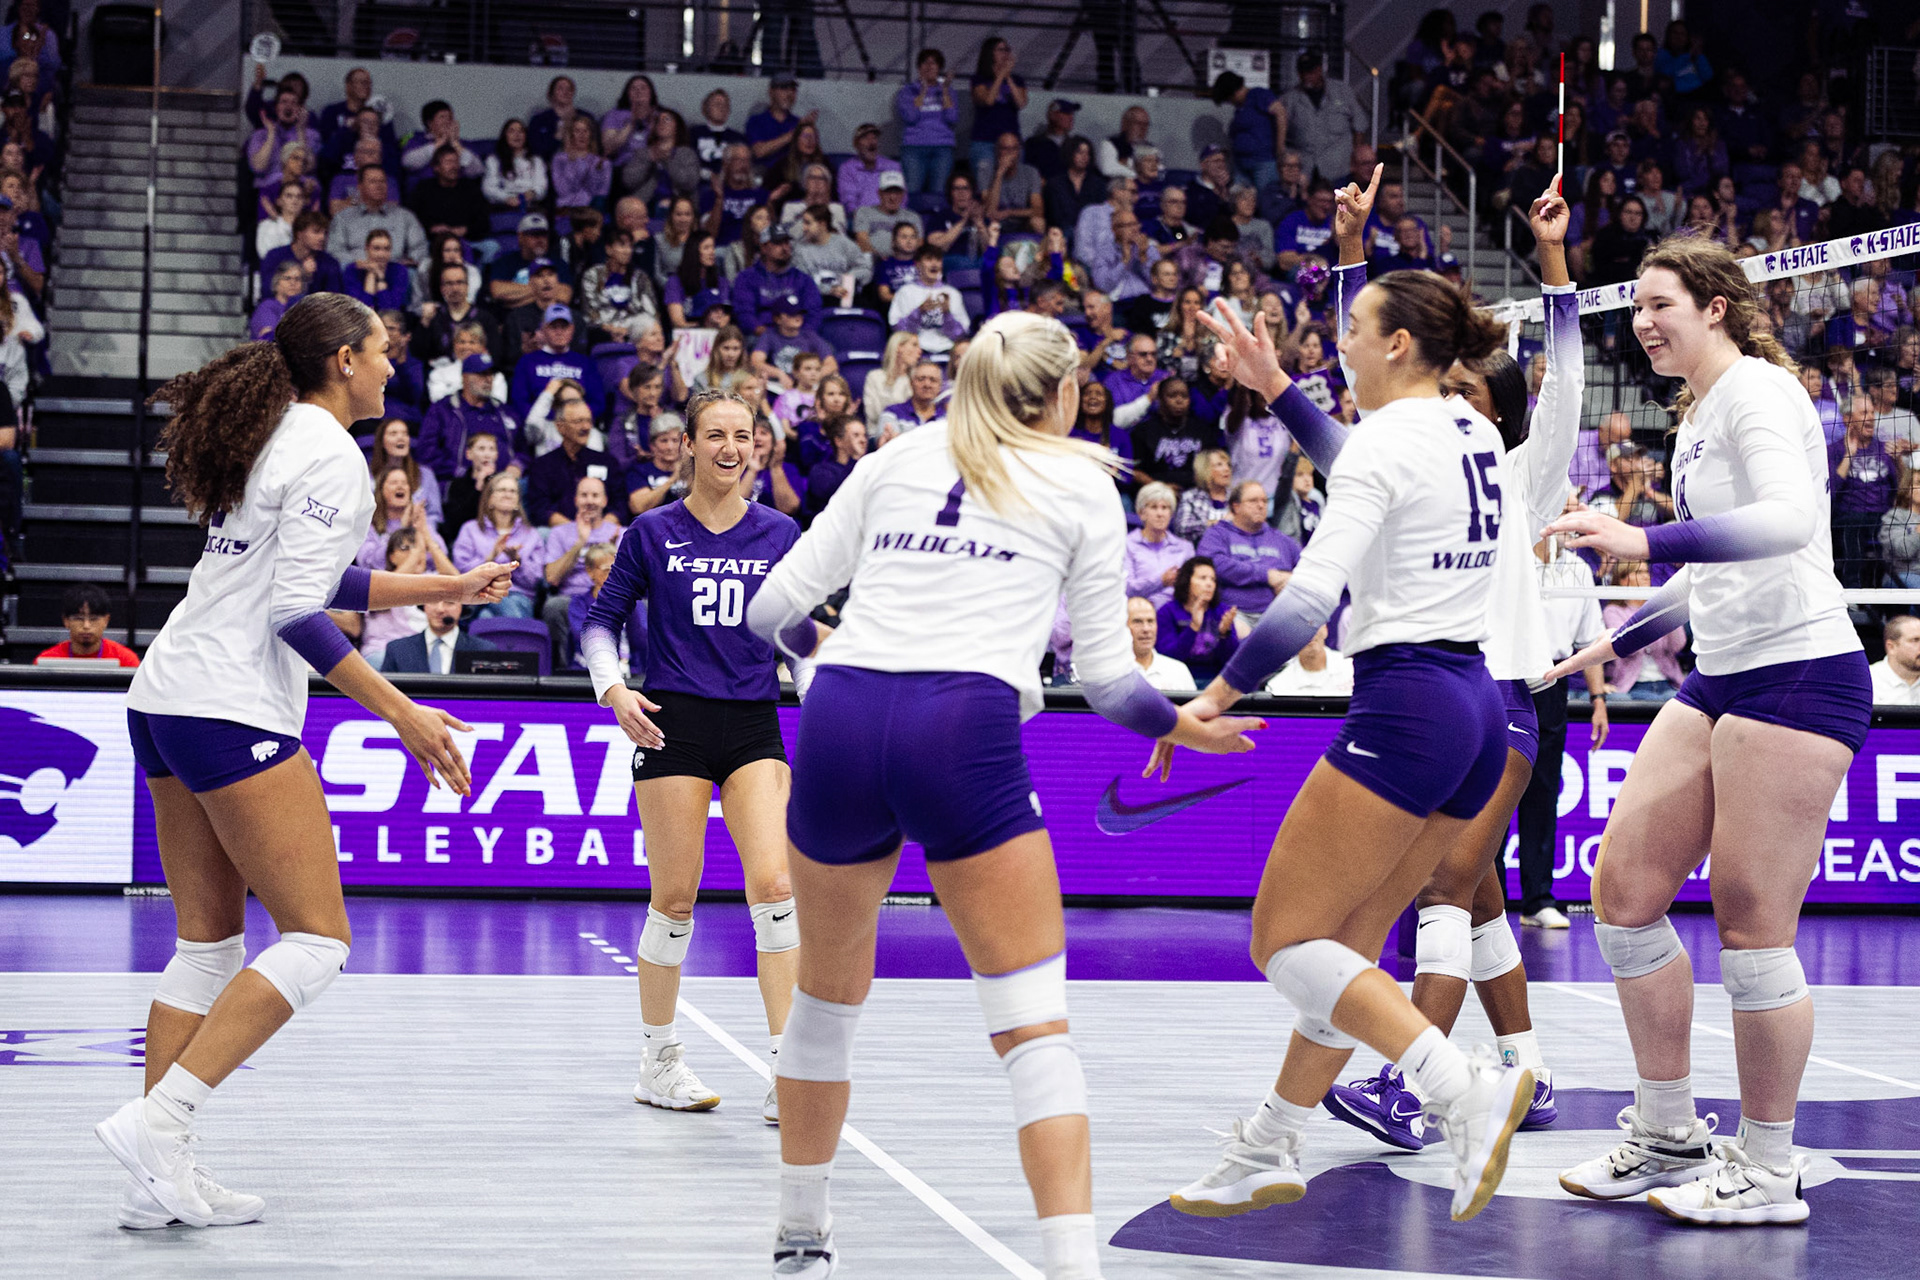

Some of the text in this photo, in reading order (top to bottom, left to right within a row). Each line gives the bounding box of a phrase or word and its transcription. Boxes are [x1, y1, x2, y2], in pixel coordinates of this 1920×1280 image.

[1867, 224, 1920, 255] K-STATE
[1780, 243, 1828, 272] K-STATE
[1577, 289, 1601, 309] TATE
[1675, 440, 1705, 476] STATE
[1462, 451, 1502, 542] 15
[666, 555, 769, 576] K-STATE
[1432, 549, 1498, 570] WILDC
[692, 577, 745, 627] 20
[313, 719, 638, 816] STAT
[332, 824, 649, 867] LLEYBAL
